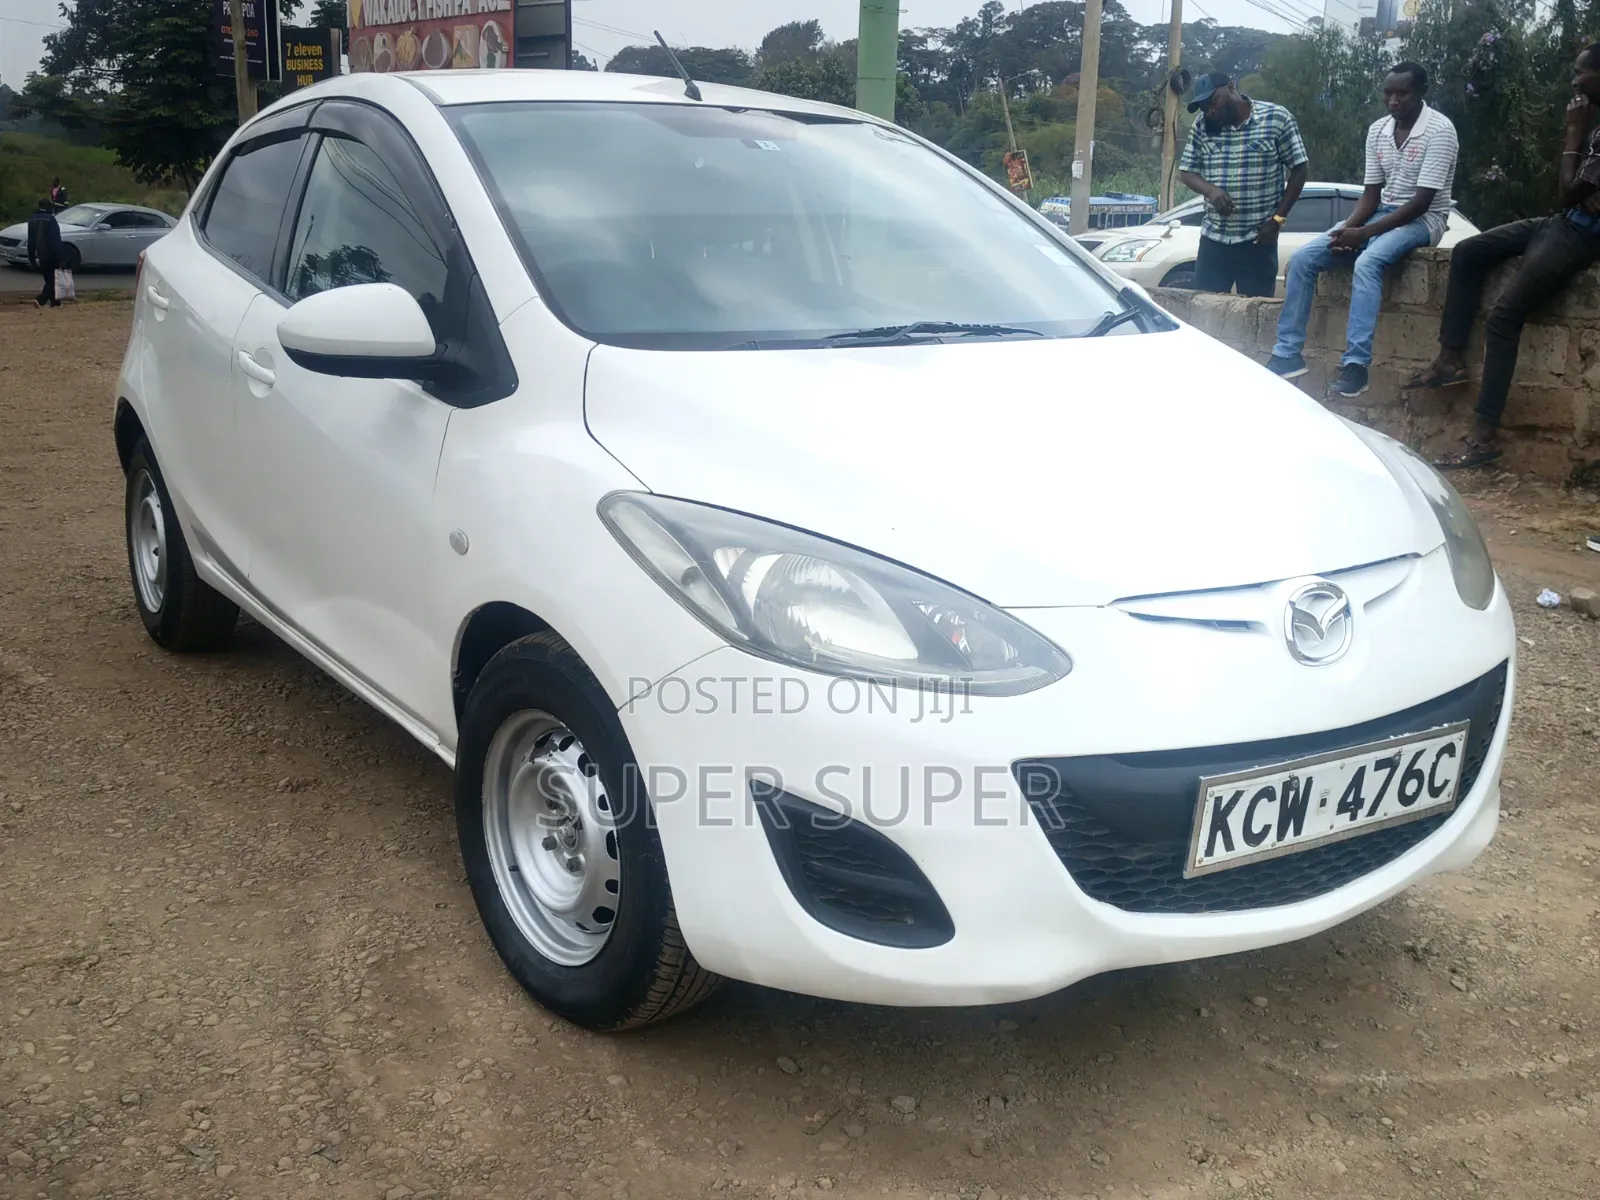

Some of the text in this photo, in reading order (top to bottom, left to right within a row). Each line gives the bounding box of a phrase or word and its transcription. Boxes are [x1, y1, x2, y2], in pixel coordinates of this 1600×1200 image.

[286, 42, 322, 56] 7 eleven
[286, 59, 324, 71] BUSINESS
[297, 75, 314, 86] HUB
[1204, 742, 1456, 858] KCW 476C
